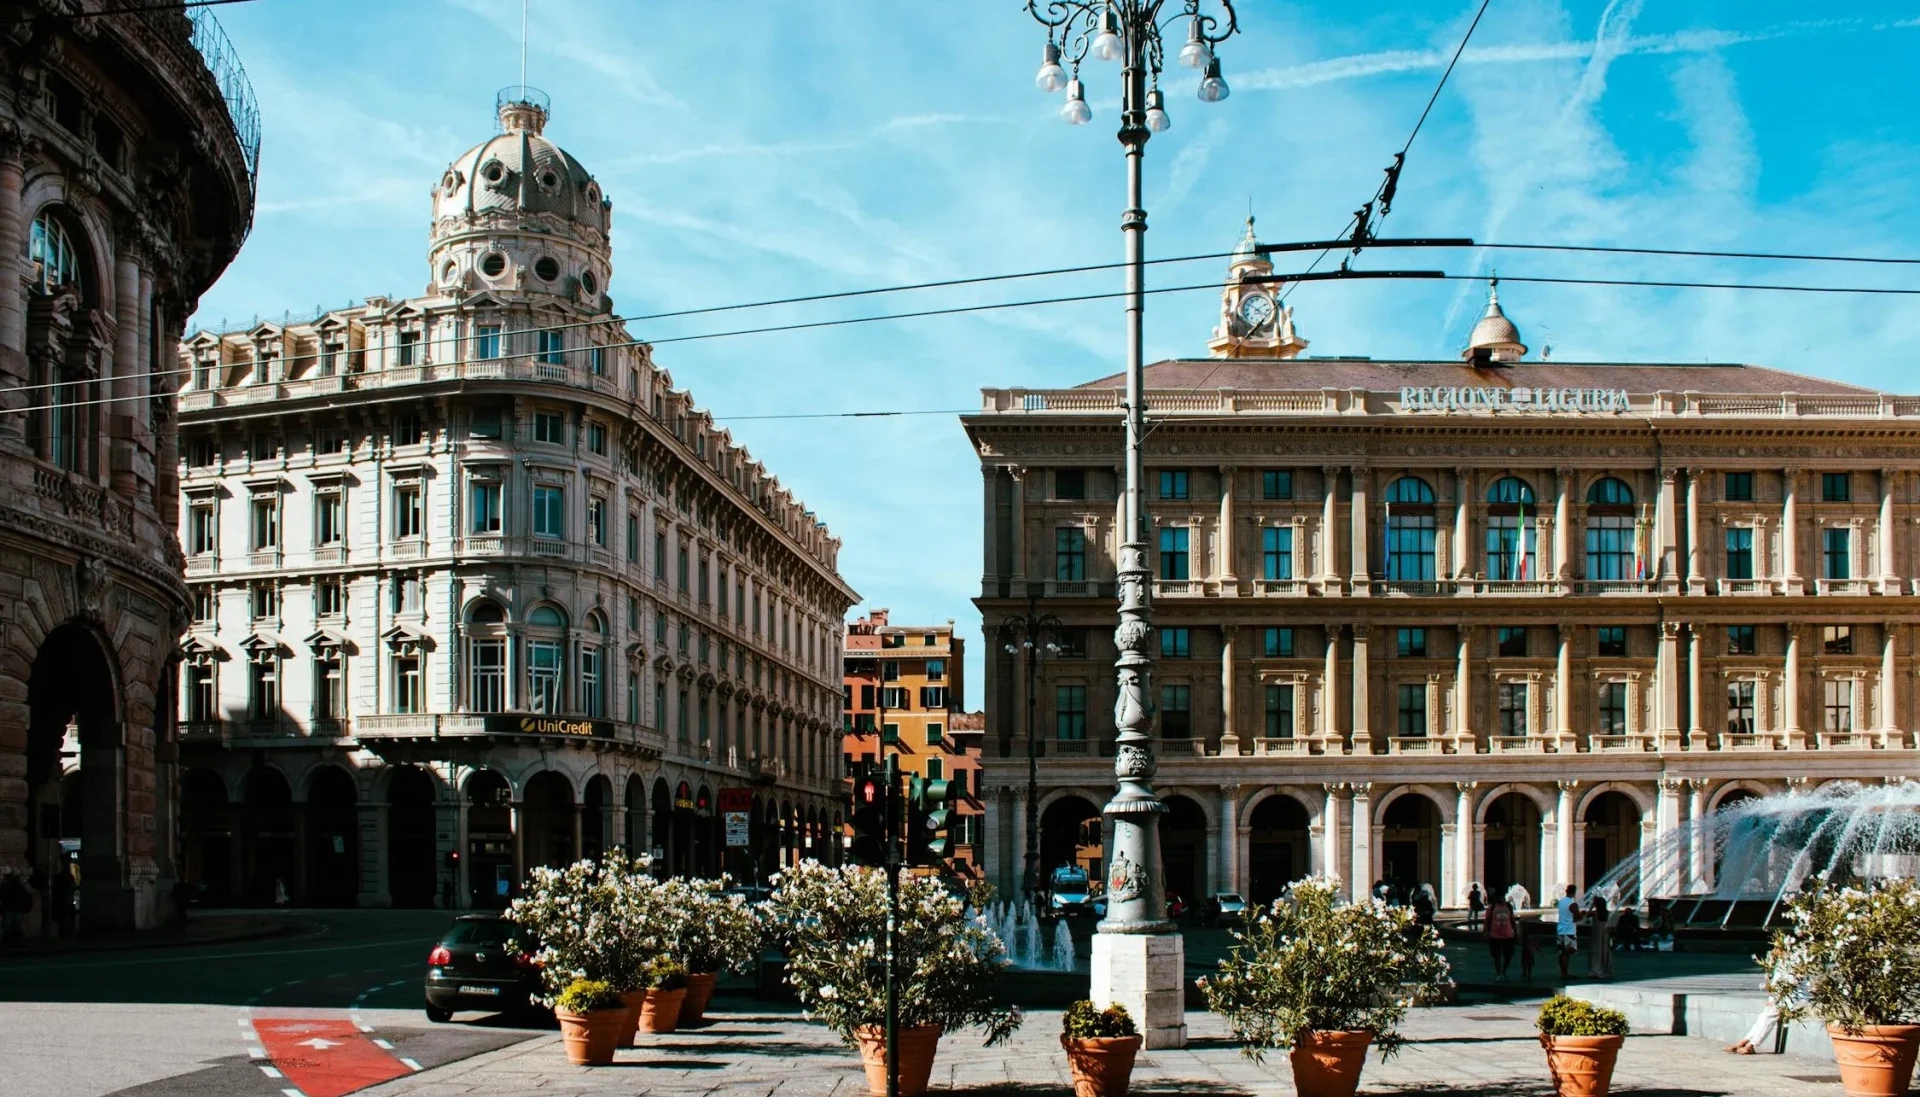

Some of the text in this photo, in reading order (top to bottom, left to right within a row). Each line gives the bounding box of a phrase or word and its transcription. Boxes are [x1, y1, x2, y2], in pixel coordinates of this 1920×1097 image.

[1400, 386, 1632, 412] REGIONE LIGURIA
[538, 719, 593, 735] UniCredit
